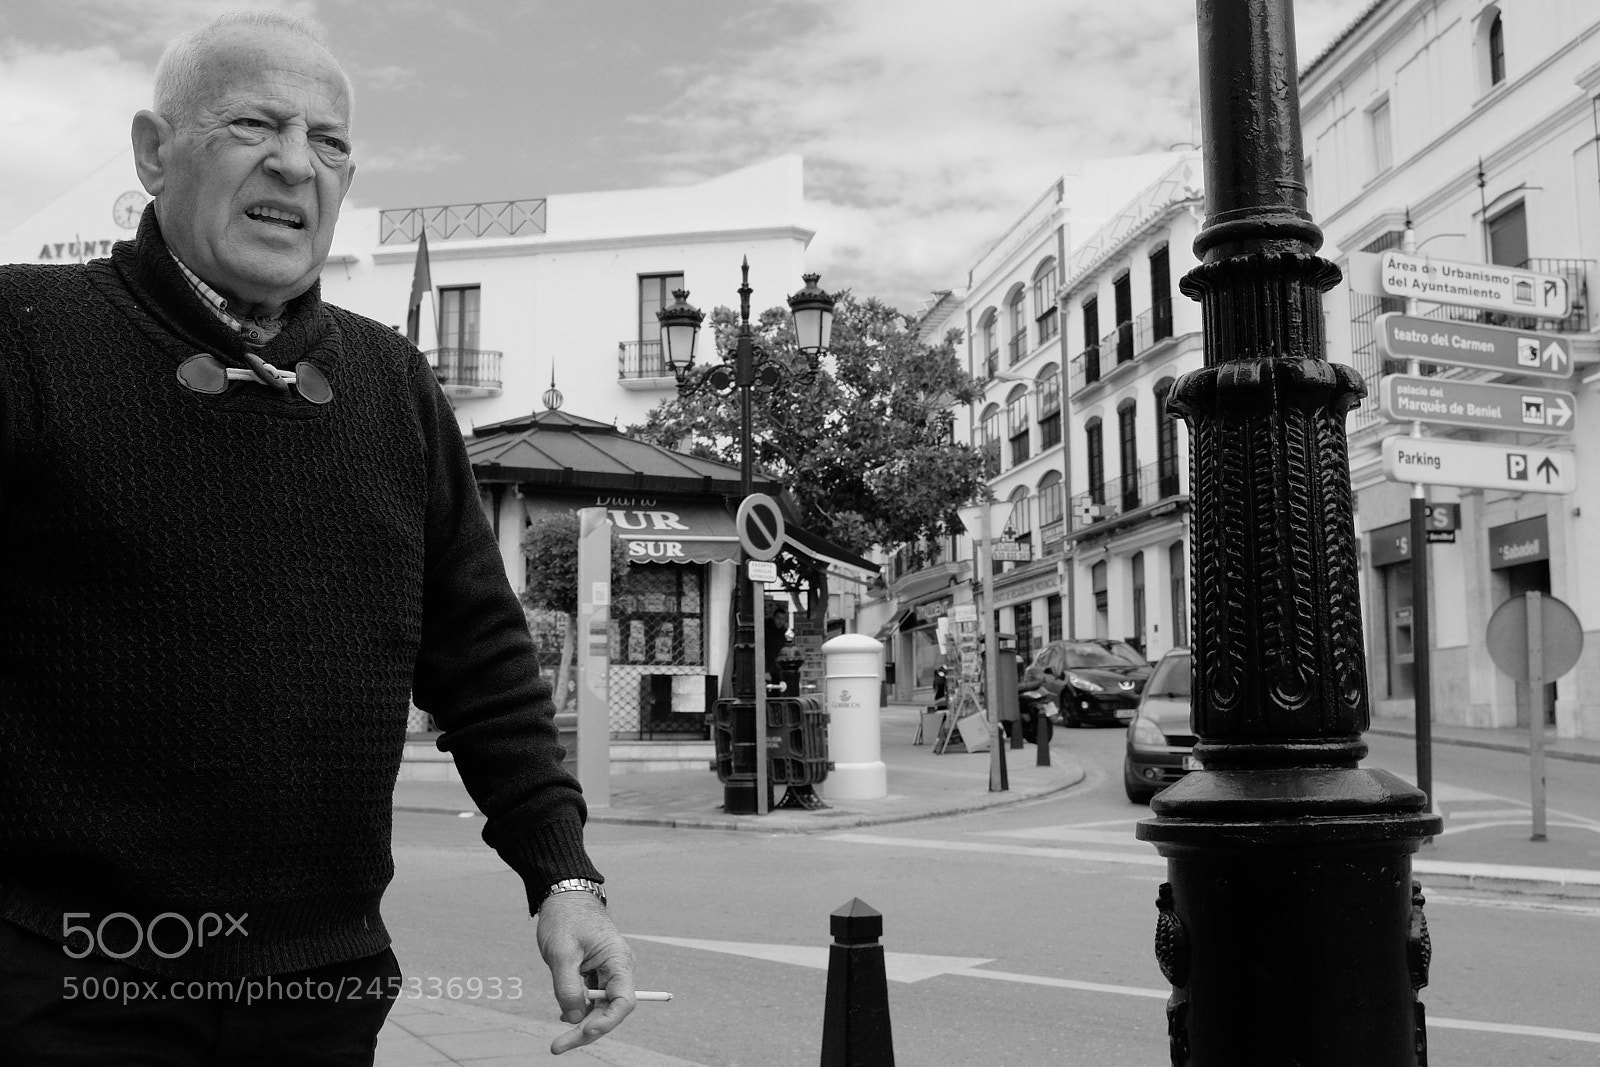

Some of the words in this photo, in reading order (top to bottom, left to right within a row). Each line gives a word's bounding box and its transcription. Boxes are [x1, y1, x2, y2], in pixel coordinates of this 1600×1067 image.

[1388, 256, 1417, 272] Área
[1442, 265, 1510, 285] Urbanismo
[1388, 276, 1407, 288] del
[1412, 278, 1501, 300] Ayuntamiento
[1394, 328, 1428, 344] teatro
[1430, 334, 1449, 346] del
[1452, 335, 1495, 353] Carmen
[1397, 385, 1428, 396] palacio
[1429, 387, 1444, 398] del
[1398, 397, 1447, 414] Marqués
[1449, 402, 1464, 415] de
[1466, 403, 1502, 419] Beniel
[1398, 451, 1441, 470] Parking
[577, 507, 690, 531] UR
[628, 541, 685, 557] SUR
